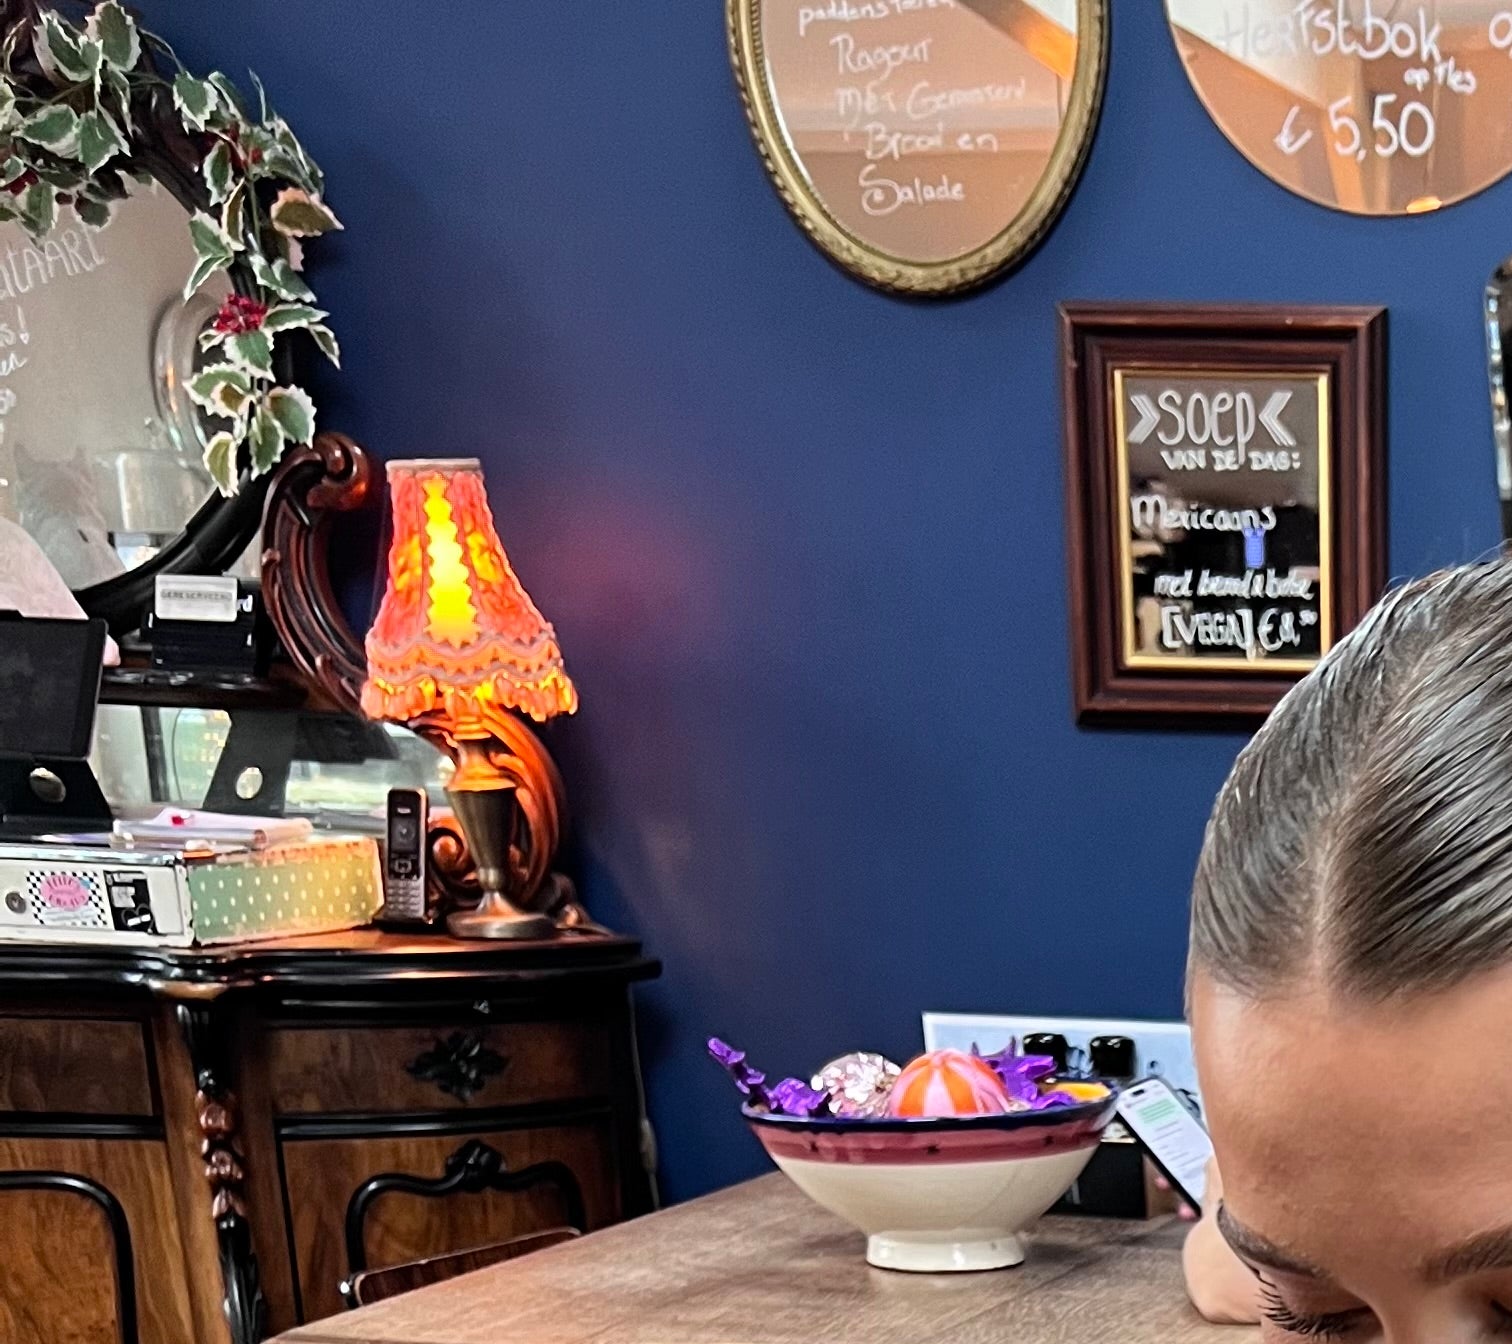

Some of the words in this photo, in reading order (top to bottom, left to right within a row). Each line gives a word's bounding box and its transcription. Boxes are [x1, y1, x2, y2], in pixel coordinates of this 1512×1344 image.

[1328, 93, 1435, 161] 5,50
[858, 164, 965, 216] Salade
[1160, 449, 1207, 471] VAN
[1211, 449, 1241, 472] DE
[1130, 493, 1277, 532] Mexicaans
